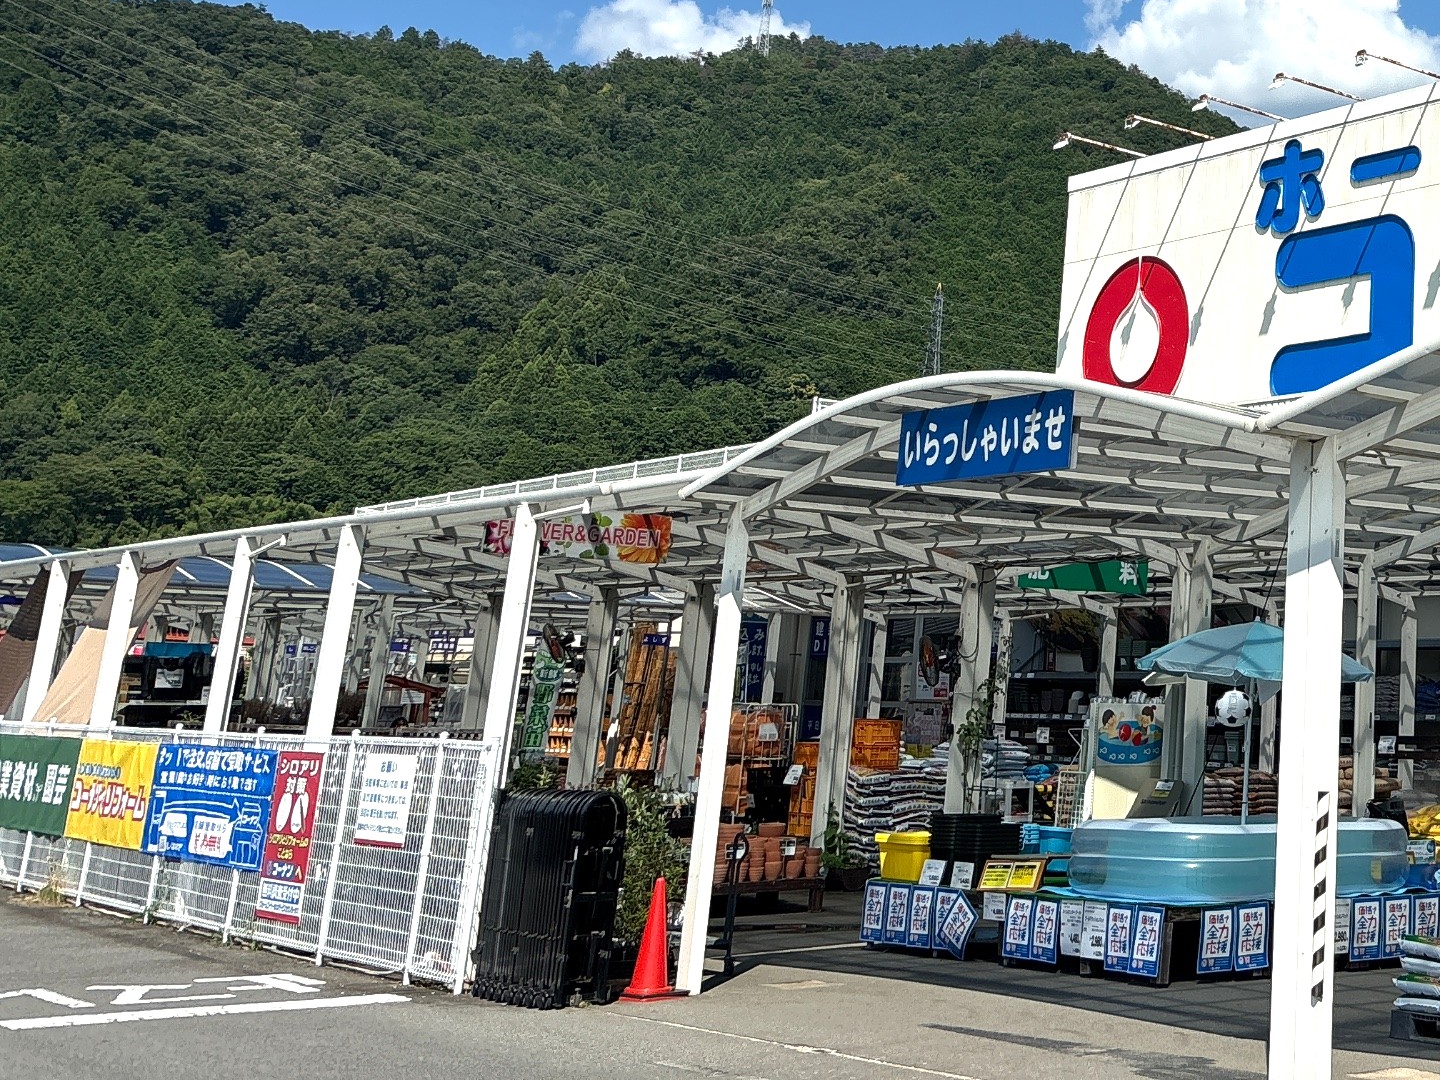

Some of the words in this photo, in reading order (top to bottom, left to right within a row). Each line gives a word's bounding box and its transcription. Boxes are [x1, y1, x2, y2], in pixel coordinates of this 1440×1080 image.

[904, 405, 1066, 469] いらっしゃいませ
[280, 758, 320, 777] シロアリ
[285, 777, 308, 795] 対策
[867, 899, 882, 912] 全力
[890, 901, 905, 914] 全力
[914, 904, 928, 918] 全力
[938, 906, 950, 919] 全
[1010, 912, 1027, 927] 全力
[1037, 915, 1053, 931] 全力
[1357, 915, 1377, 930] 全力
[1388, 914, 1406, 927] 全力
[1417, 911, 1436, 925] 全力
[1110, 923, 1127, 938] 全力
[1138, 926, 1156, 942] 全力
[1207, 924, 1228, 939] 全力
[1242, 921, 1262, 937] 全力
[1388, 928, 1406, 941] 応援
[1417, 926, 1435, 937] 応援
[1241, 936, 1262, 952] 応援
[1357, 930, 1375, 944] 応援
[1110, 939, 1127, 954] 応援
[1136, 942, 1155, 957] 応援
[1205, 939, 1228, 954] 応援
